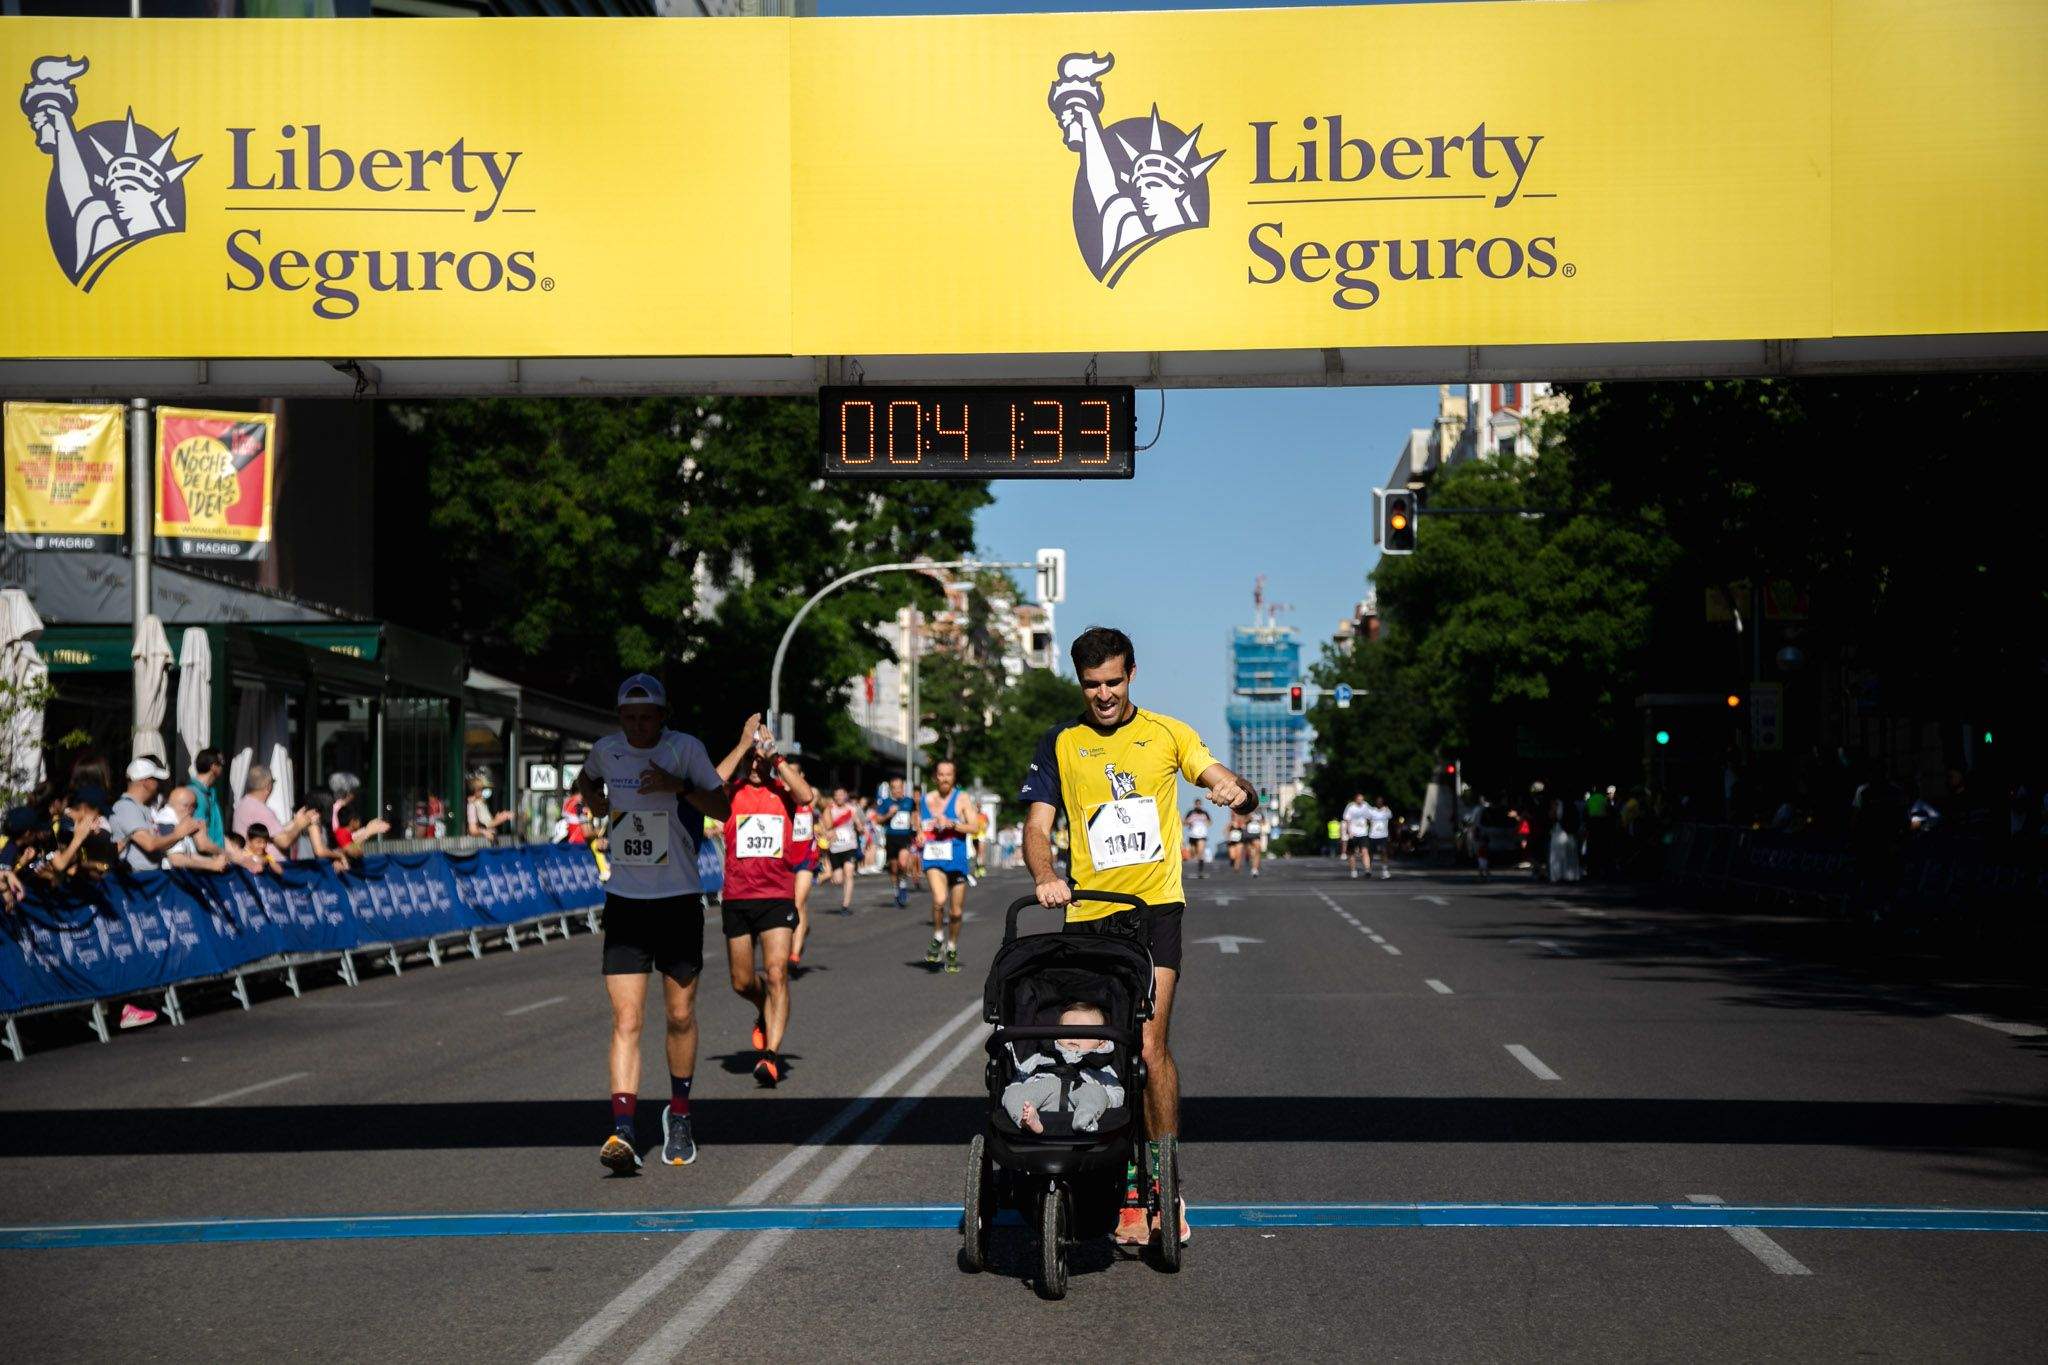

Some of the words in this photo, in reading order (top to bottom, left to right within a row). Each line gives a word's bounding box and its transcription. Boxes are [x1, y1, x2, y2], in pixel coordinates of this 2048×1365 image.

[1248, 114, 1545, 208] Liberty
[226, 124, 523, 222] Liberty
[840, 400, 1111, 464] 00:41:33
[174, 447, 227, 474] NOCHE
[48, 537, 95, 550] MADRID
[195, 542, 241, 555] MADRID
[623, 838, 654, 857] 639
[746, 836, 774, 850] 3377
